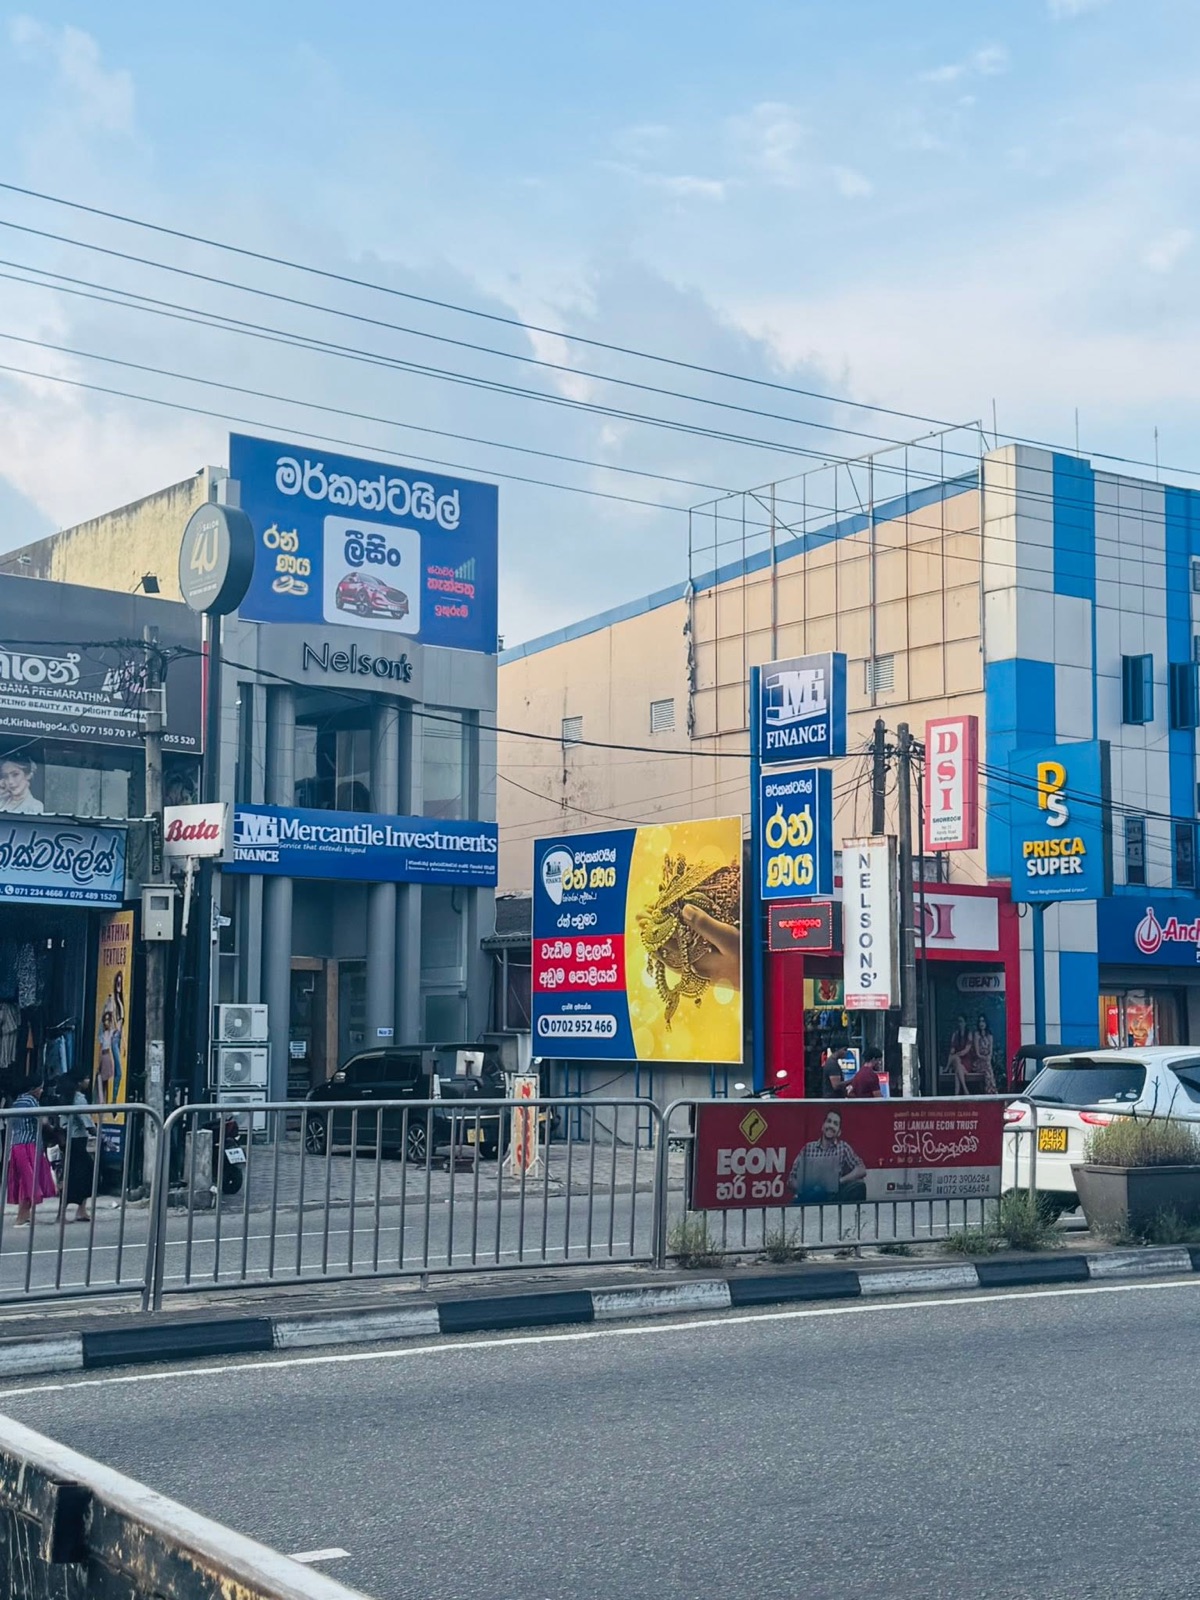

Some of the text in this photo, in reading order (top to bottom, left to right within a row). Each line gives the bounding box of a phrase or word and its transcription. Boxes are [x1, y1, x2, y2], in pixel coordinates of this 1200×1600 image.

[275, 456, 461, 531] මර්කන්ටයිල්
[263, 523, 299, 552] රන්
[344, 530, 401, 567] ලීසිං
[276, 553, 311, 576] ණය
[303, 642, 413, 683] Nelson's
[32, 686, 110, 703] PREMARATHNA
[28, 701, 60, 711] BEAUTY
[62, 704, 73, 712] AT
[81, 725, 96, 735] 077
[99, 727, 113, 736] 150
[115, 728, 125, 737] 70
[164, 734, 179, 743] 055
[180, 736, 196, 745] 520
[766, 724, 827, 749] FINANCE
[936, 731, 959, 811] DSI
[765, 778, 813, 801] මර්කන්ටයිල්
[165, 819, 220, 842] Bata
[279, 817, 497, 853] Mercantile Investments
[765, 801, 813, 850] රන්
[233, 848, 279, 862] INANCE
[304, 842, 317, 851] that
[1022, 837, 1086, 859] PRISCA
[562, 863, 616, 890] රන් ණය
[766, 852, 814, 888] ණය
[1026, 857, 1084, 877] SUPER
[15, 887, 28, 896] 071
[100, 893, 117, 901] 1520
[103, 947, 127, 966] TEXTILES
[539, 967, 565, 988] අඩුම
[551, 1020, 612, 1033] 0702 952 466
[894, 1120, 978, 1131] SRI LANKAN ECON TRUST
[717, 1147, 787, 1176] ECON
[716, 1173, 784, 1200] හරි පාර
[944, 1175, 957, 1184] 072
[944, 1185, 957, 1194] 072
